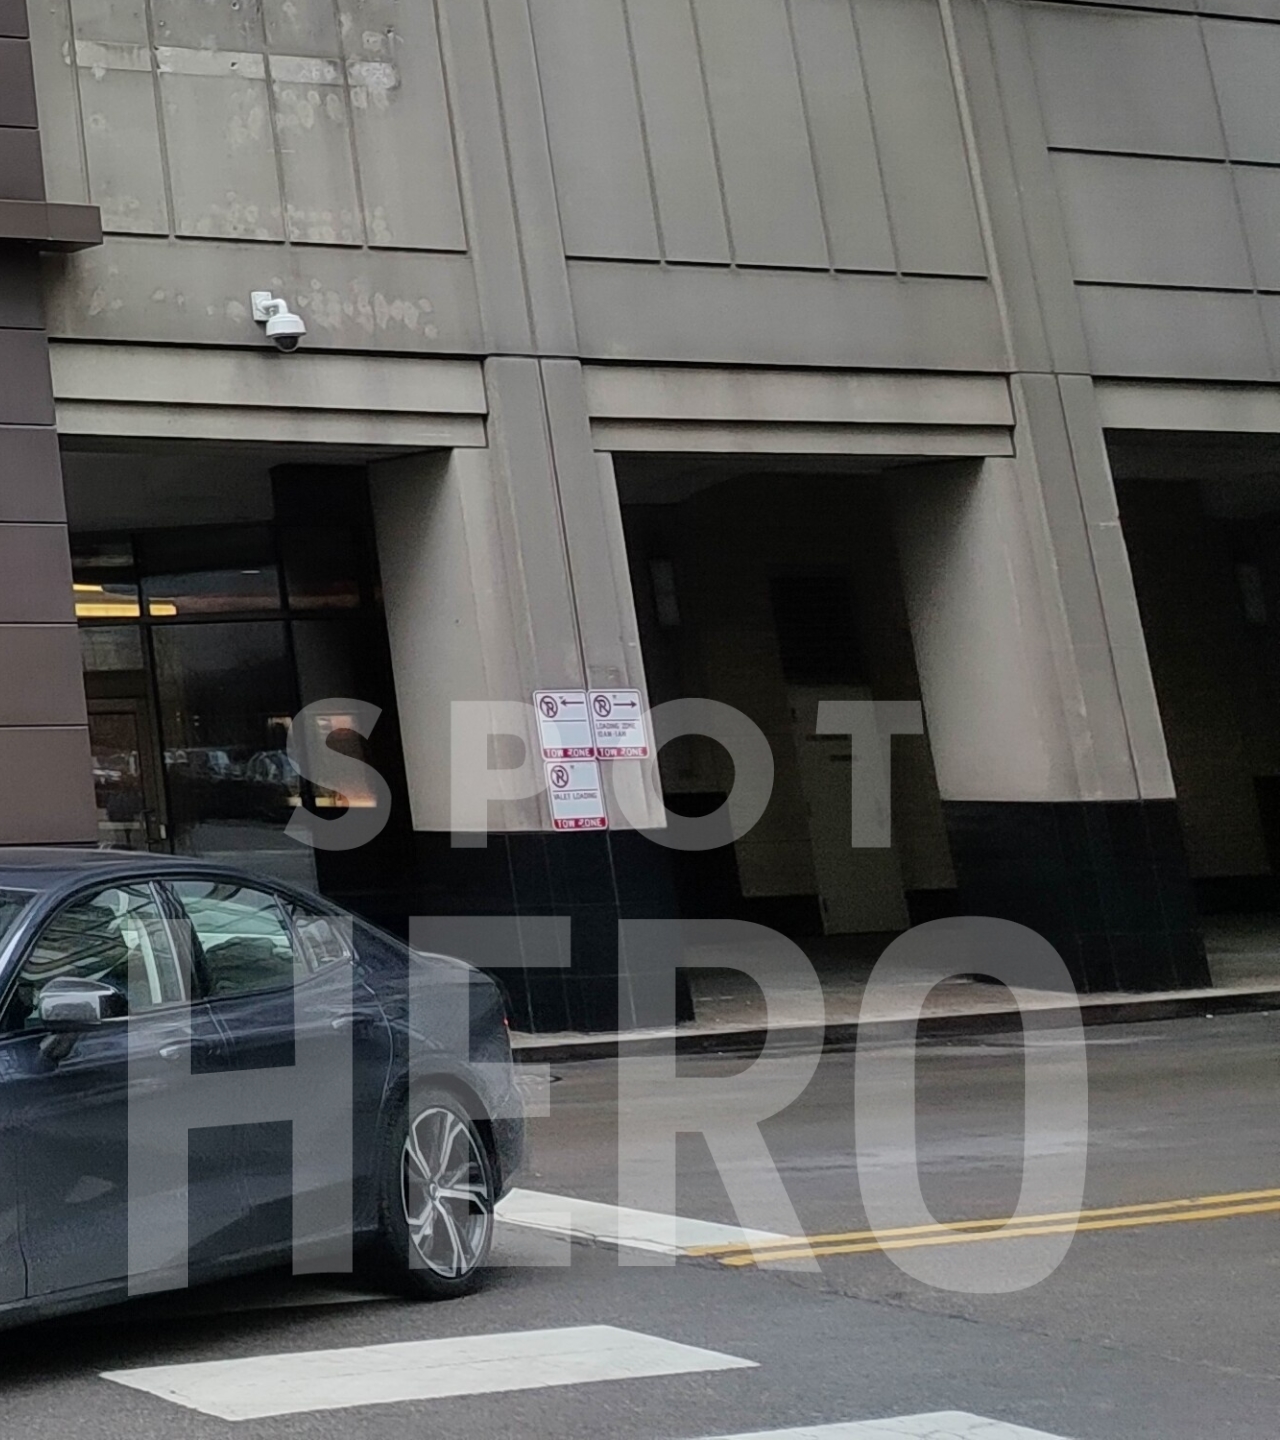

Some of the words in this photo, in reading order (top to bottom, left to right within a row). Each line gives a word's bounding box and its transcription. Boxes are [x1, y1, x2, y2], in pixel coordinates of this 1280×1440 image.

[546, 749, 565, 758] TOW
[567, 748, 592, 757] ZONE
[599, 748, 618, 757] TOW
[620, 747, 645, 757] ZONE
[553, 792, 571, 801] VALET
[572, 791, 598, 800] LOADING
[557, 819, 576, 828] TOW
[577, 818, 603, 828] ZONE
